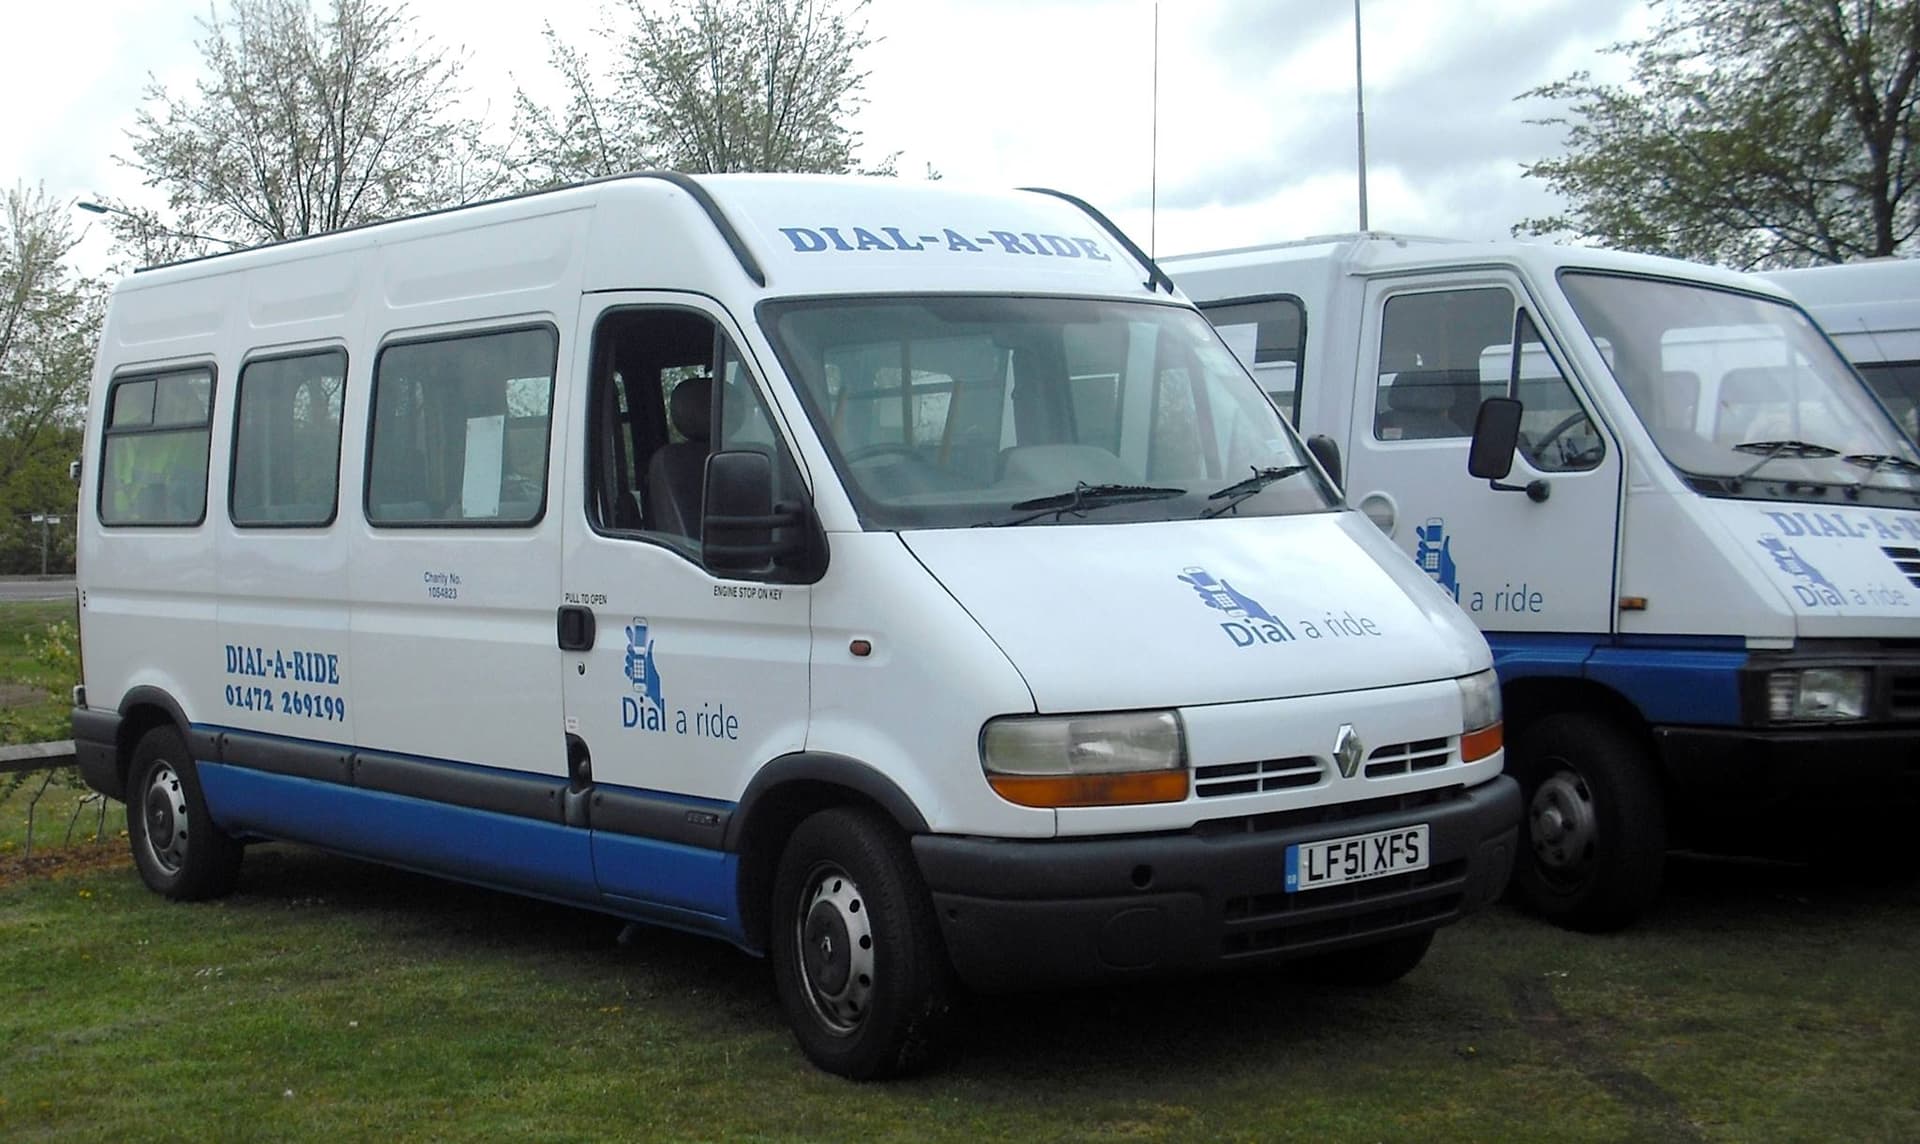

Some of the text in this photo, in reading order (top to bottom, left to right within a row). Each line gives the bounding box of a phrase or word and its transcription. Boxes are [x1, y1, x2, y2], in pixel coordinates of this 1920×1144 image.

[778, 227, 1112, 262] DIAL-A-RIDE
[1761, 511, 1920, 540] DIAL-A-R
[713, 585, 783, 600] ENGINE STOP ON KEY
[1470, 591, 1484, 612] a
[1494, 583, 1543, 613] ride
[1792, 584, 1848, 607] Dial
[1220, 610, 1382, 648] Dial a ride
[226, 644, 340, 685] DIAL-A-RIDE
[225, 684, 345, 722] 01472 269199
[622, 695, 738, 740] Dial a ride
[1308, 831, 1419, 882] LF51 XFS
